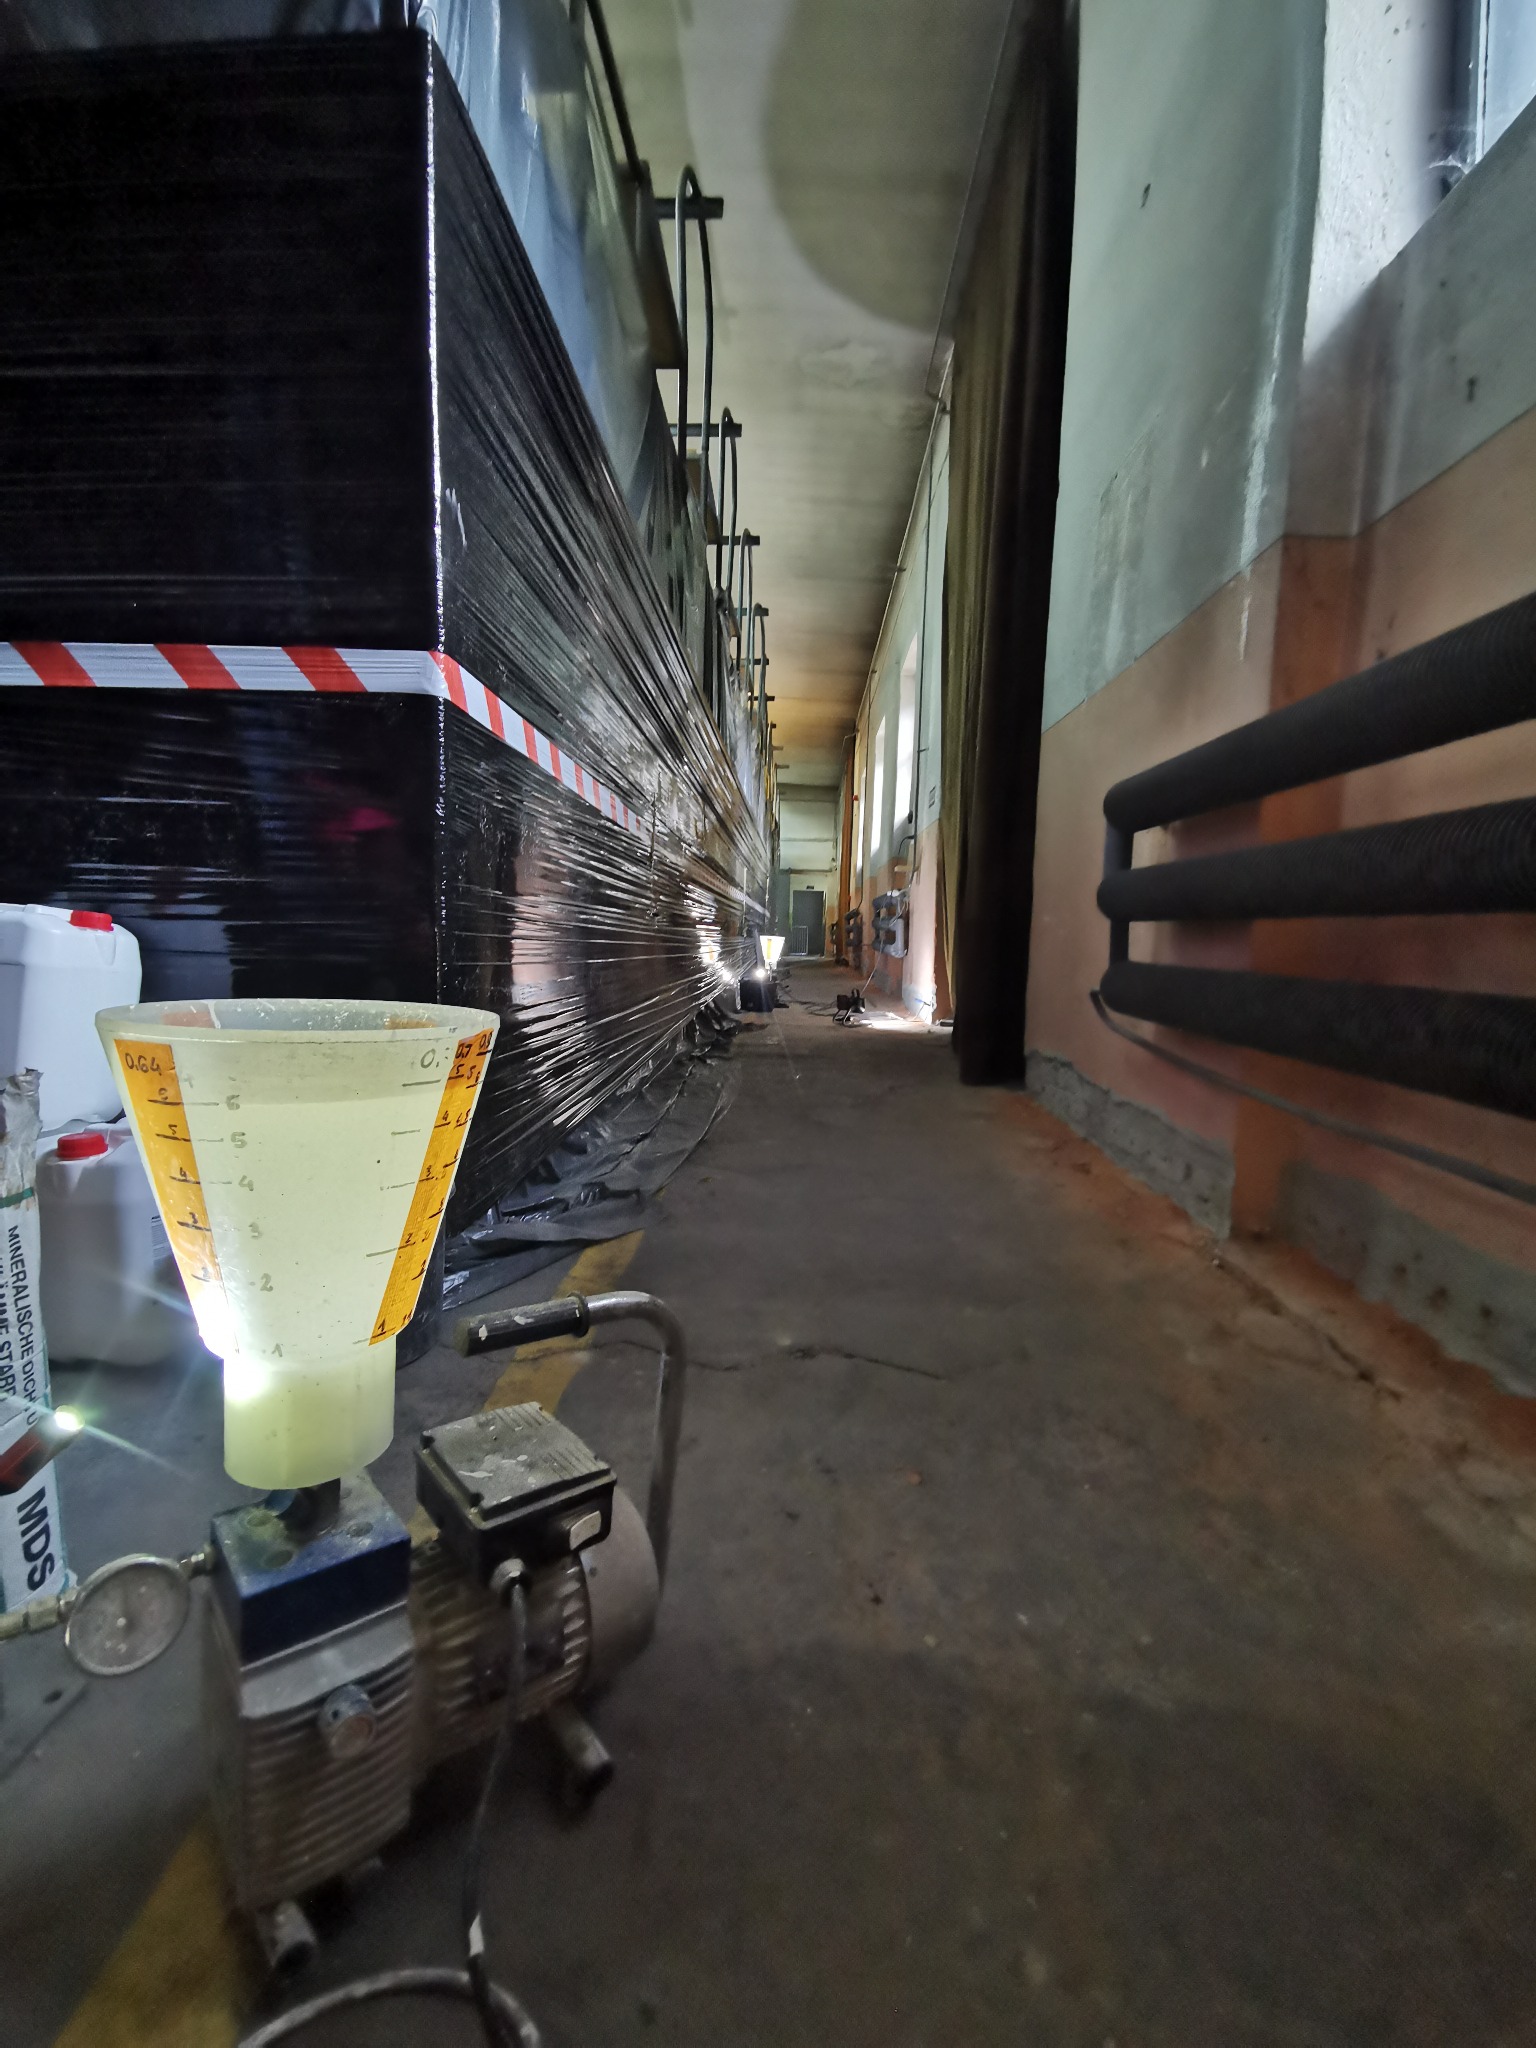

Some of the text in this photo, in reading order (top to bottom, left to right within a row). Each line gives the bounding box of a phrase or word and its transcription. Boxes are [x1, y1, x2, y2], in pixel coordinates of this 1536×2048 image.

[226, 1094, 241, 1111] 6
[230, 1131, 247, 1149] 5
[238, 1174, 255, 1192] 4
[248, 1221, 262, 1240] 3
[260, 1272, 274, 1292] 2
[8, 1224, 35, 1360] MINERALISCHE
[271, 1342, 283, 1358] 1
[16, 1485, 55, 1592] MDS
